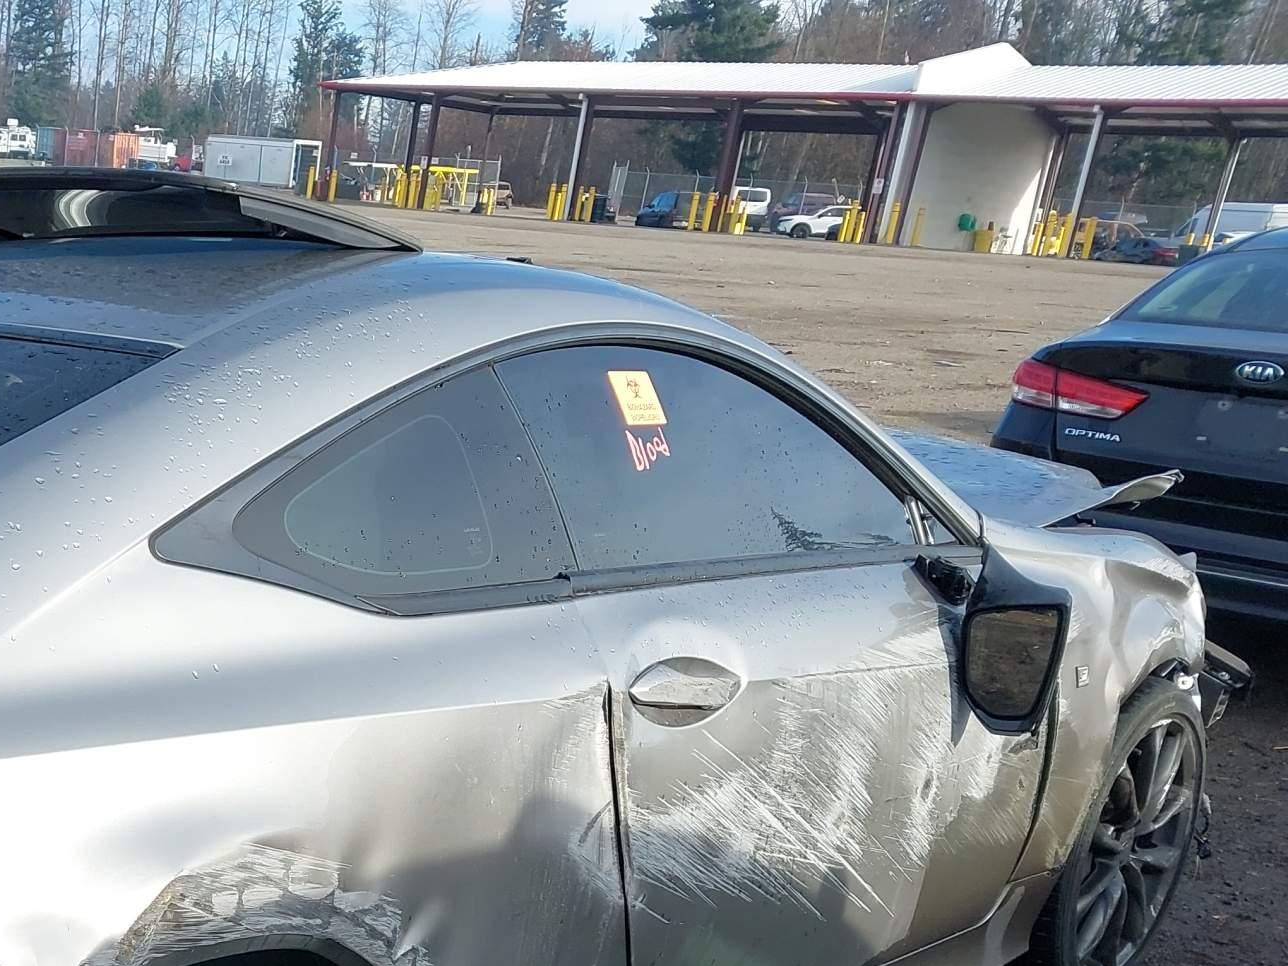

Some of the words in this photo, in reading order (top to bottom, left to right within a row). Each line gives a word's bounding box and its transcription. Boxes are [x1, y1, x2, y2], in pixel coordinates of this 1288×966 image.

[1243, 365, 1275, 380] KIA
[1064, 427, 1121, 443] OPTIMA
[625, 426, 671, 471] Blood
